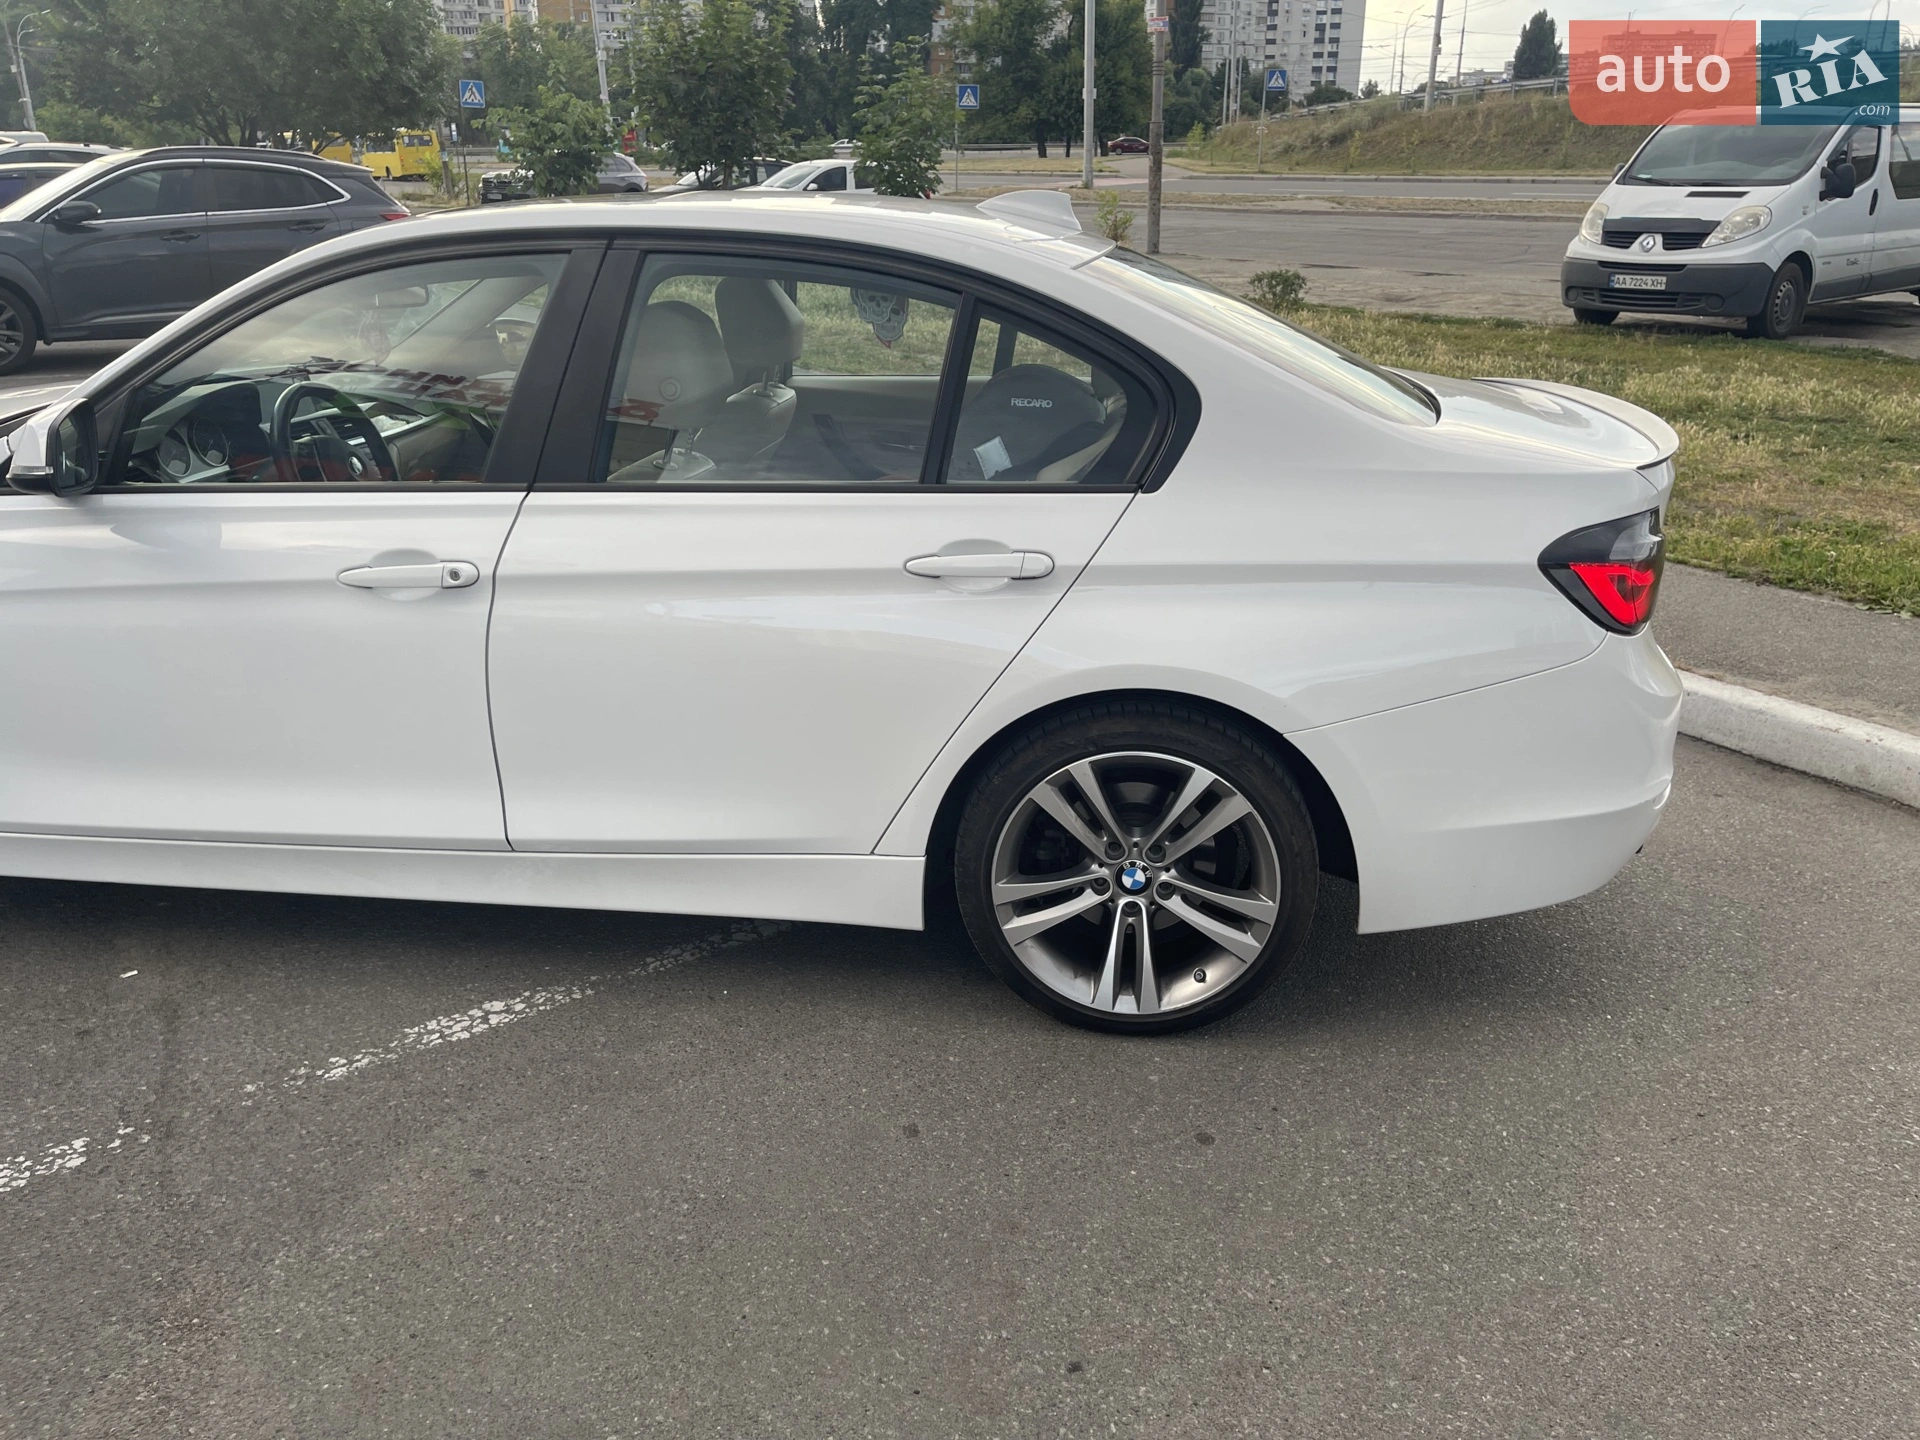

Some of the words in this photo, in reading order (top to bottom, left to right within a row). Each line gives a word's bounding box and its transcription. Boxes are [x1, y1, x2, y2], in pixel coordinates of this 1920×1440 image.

[1615, 277, 1627, 287] AA
[1629, 277, 1649, 288] 7224
[1010, 397, 1053, 408] RECARO
[1122, 862, 1153, 878] BMW
